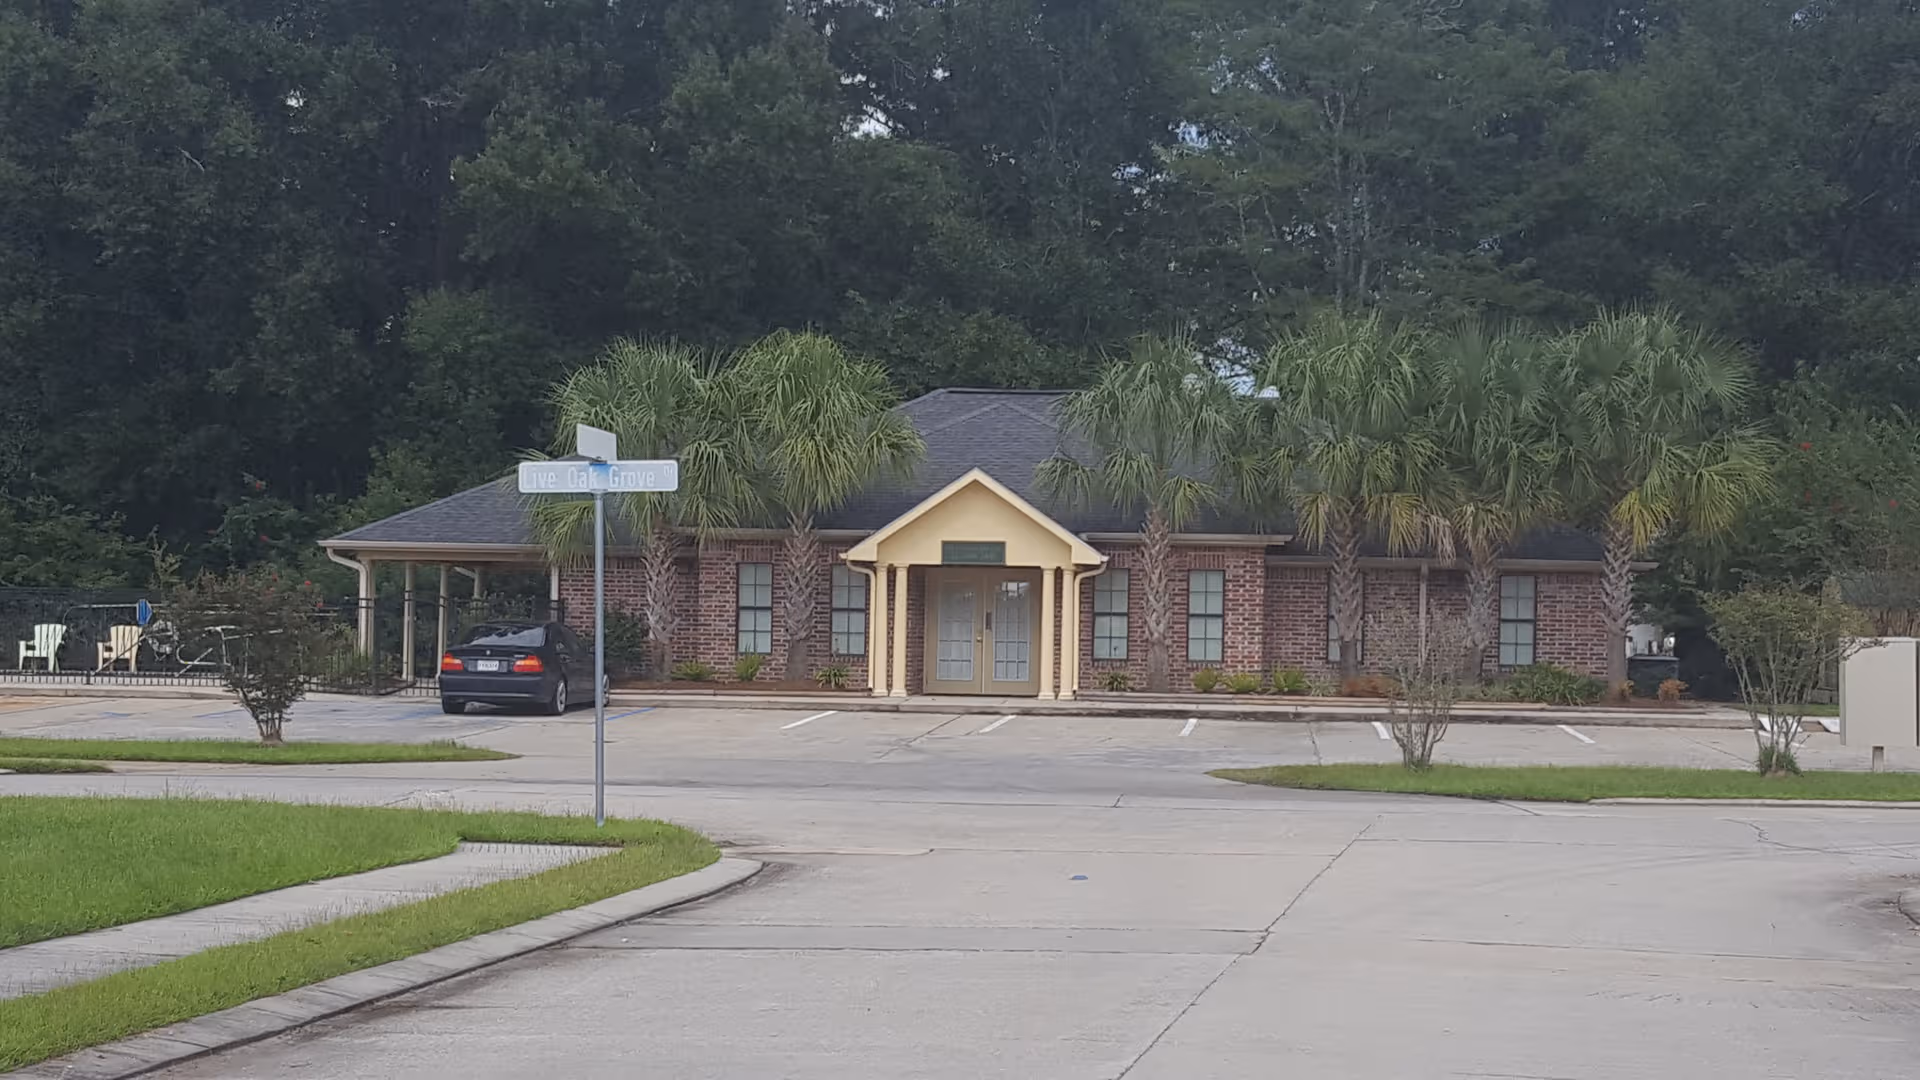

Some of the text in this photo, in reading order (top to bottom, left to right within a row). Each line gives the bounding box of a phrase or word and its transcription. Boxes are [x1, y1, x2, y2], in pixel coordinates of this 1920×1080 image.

[523, 467, 556, 489] Live
[568, 467, 598, 489] Oak
[608, 466, 655, 488] Grove
